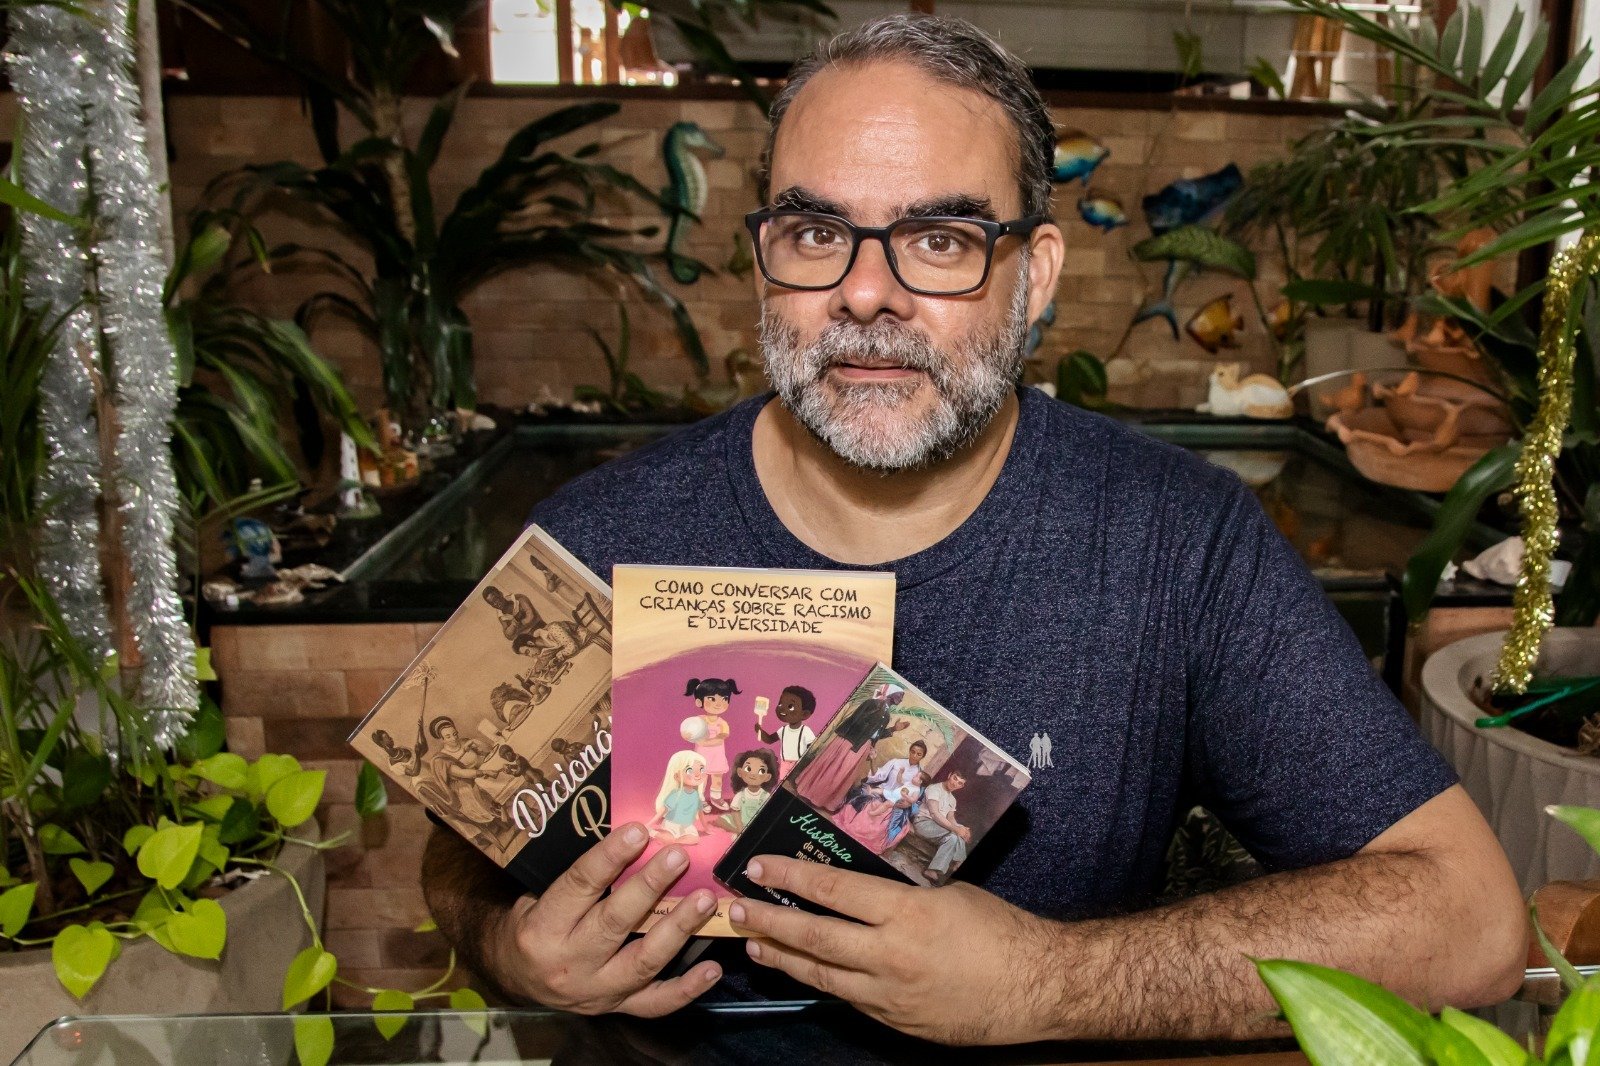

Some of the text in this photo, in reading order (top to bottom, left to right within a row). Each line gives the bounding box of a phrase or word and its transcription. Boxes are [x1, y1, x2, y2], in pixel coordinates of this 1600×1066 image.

[654, 579, 857, 602] COMO CONVERSAR COM
[639, 595, 871, 620] CRIANÇAS SOBRE RACISMO
[687, 615, 823, 634] E DIVERSIDADE
[512, 716, 612, 839] Dicioná
[803, 841, 814, 851] da
